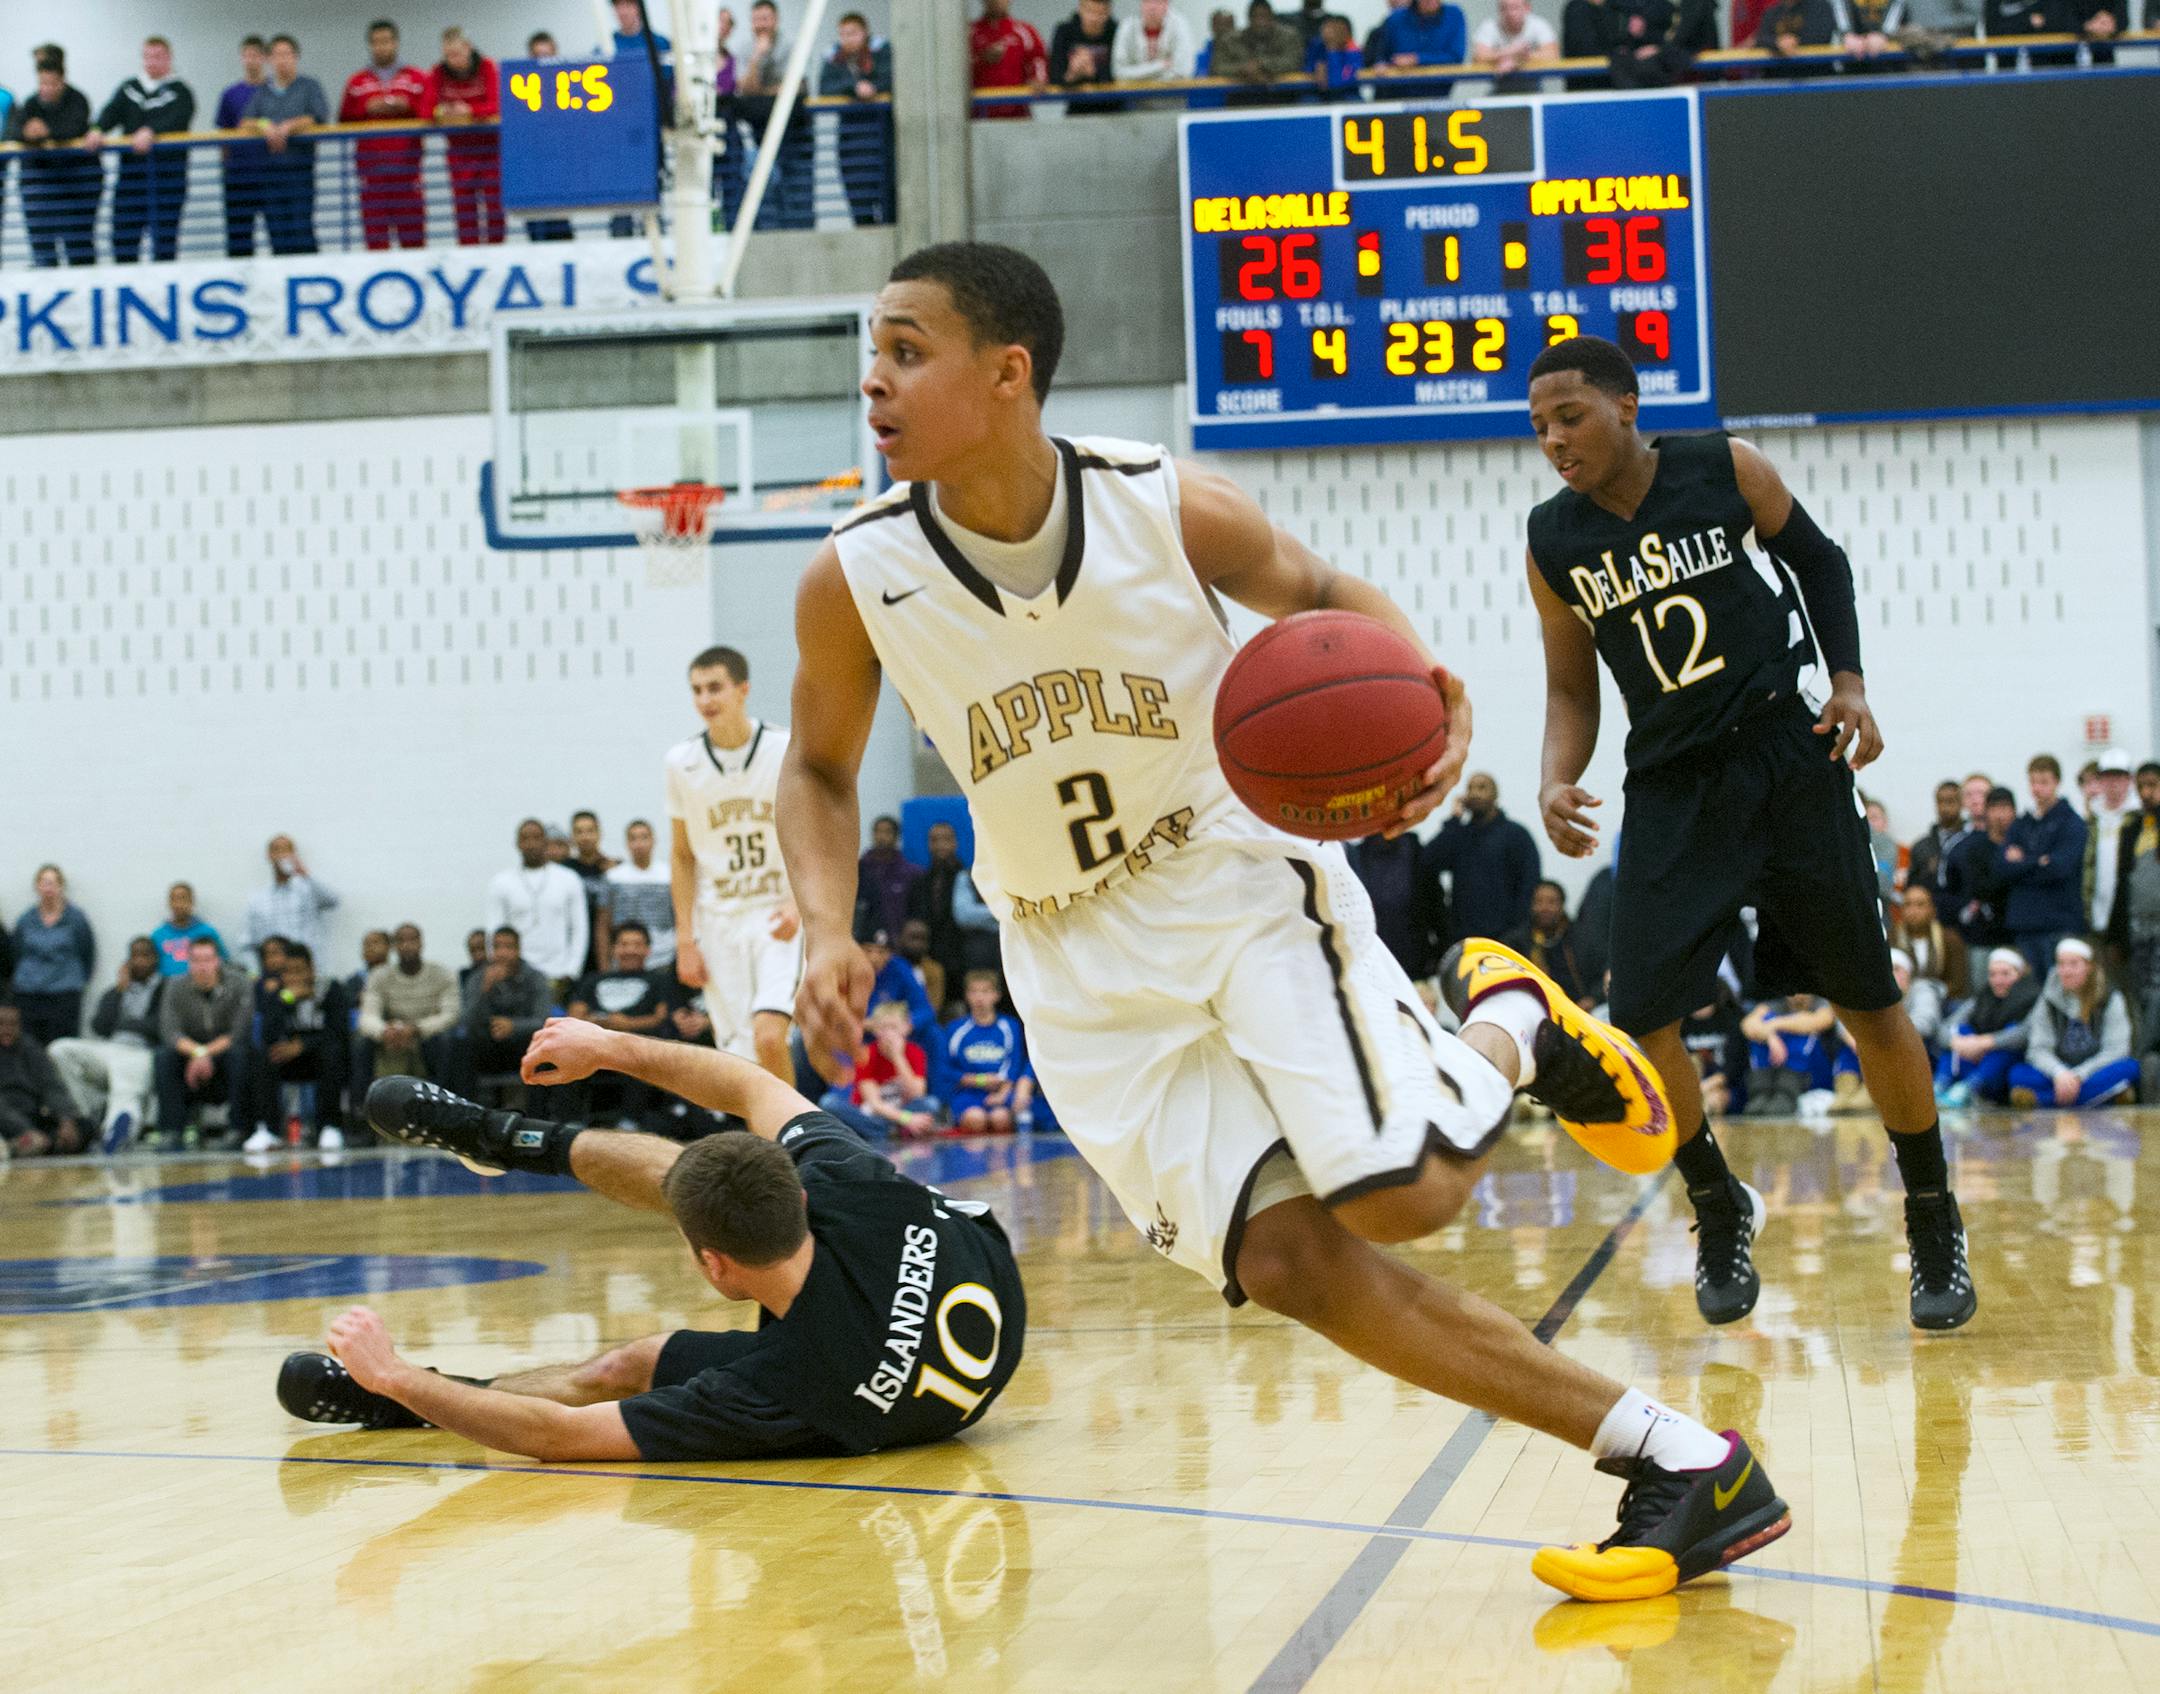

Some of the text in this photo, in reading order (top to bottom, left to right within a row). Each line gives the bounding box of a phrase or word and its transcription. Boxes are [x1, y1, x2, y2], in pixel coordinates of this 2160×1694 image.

[1344, 109, 1488, 175] 41.5
[1405, 203, 1480, 230] PERIOD
[1239, 233, 1321, 300] 26
[1444, 235, 1460, 281] 1
[1585, 216, 1666, 284] 36
[1215, 304, 1282, 331] FOULS
[1380, 293, 1512, 322] PLAYER FOUL
[1609, 285, 1677, 312] FOULS
[1242, 329, 1273, 378] 7
[1312, 328, 1347, 375] 4
[1386, 320, 1454, 375] 23
[1473, 318, 1505, 371] 2
[1635, 310, 1669, 360] 9
[1216, 387, 1282, 413] SCORE
[1415, 379, 1488, 404] MATCH
[1638, 369, 1680, 394] ORE
[1569, 526, 1733, 619] DELASALLE
[1631, 594, 1726, 693] 12
[967, 668, 1179, 784] APPLE
[1053, 769, 1127, 874] 2
[725, 831, 766, 872] 35
[854, 1224, 938, 1414] ISLANDERS
[913, 1282, 1002, 1421] 10
